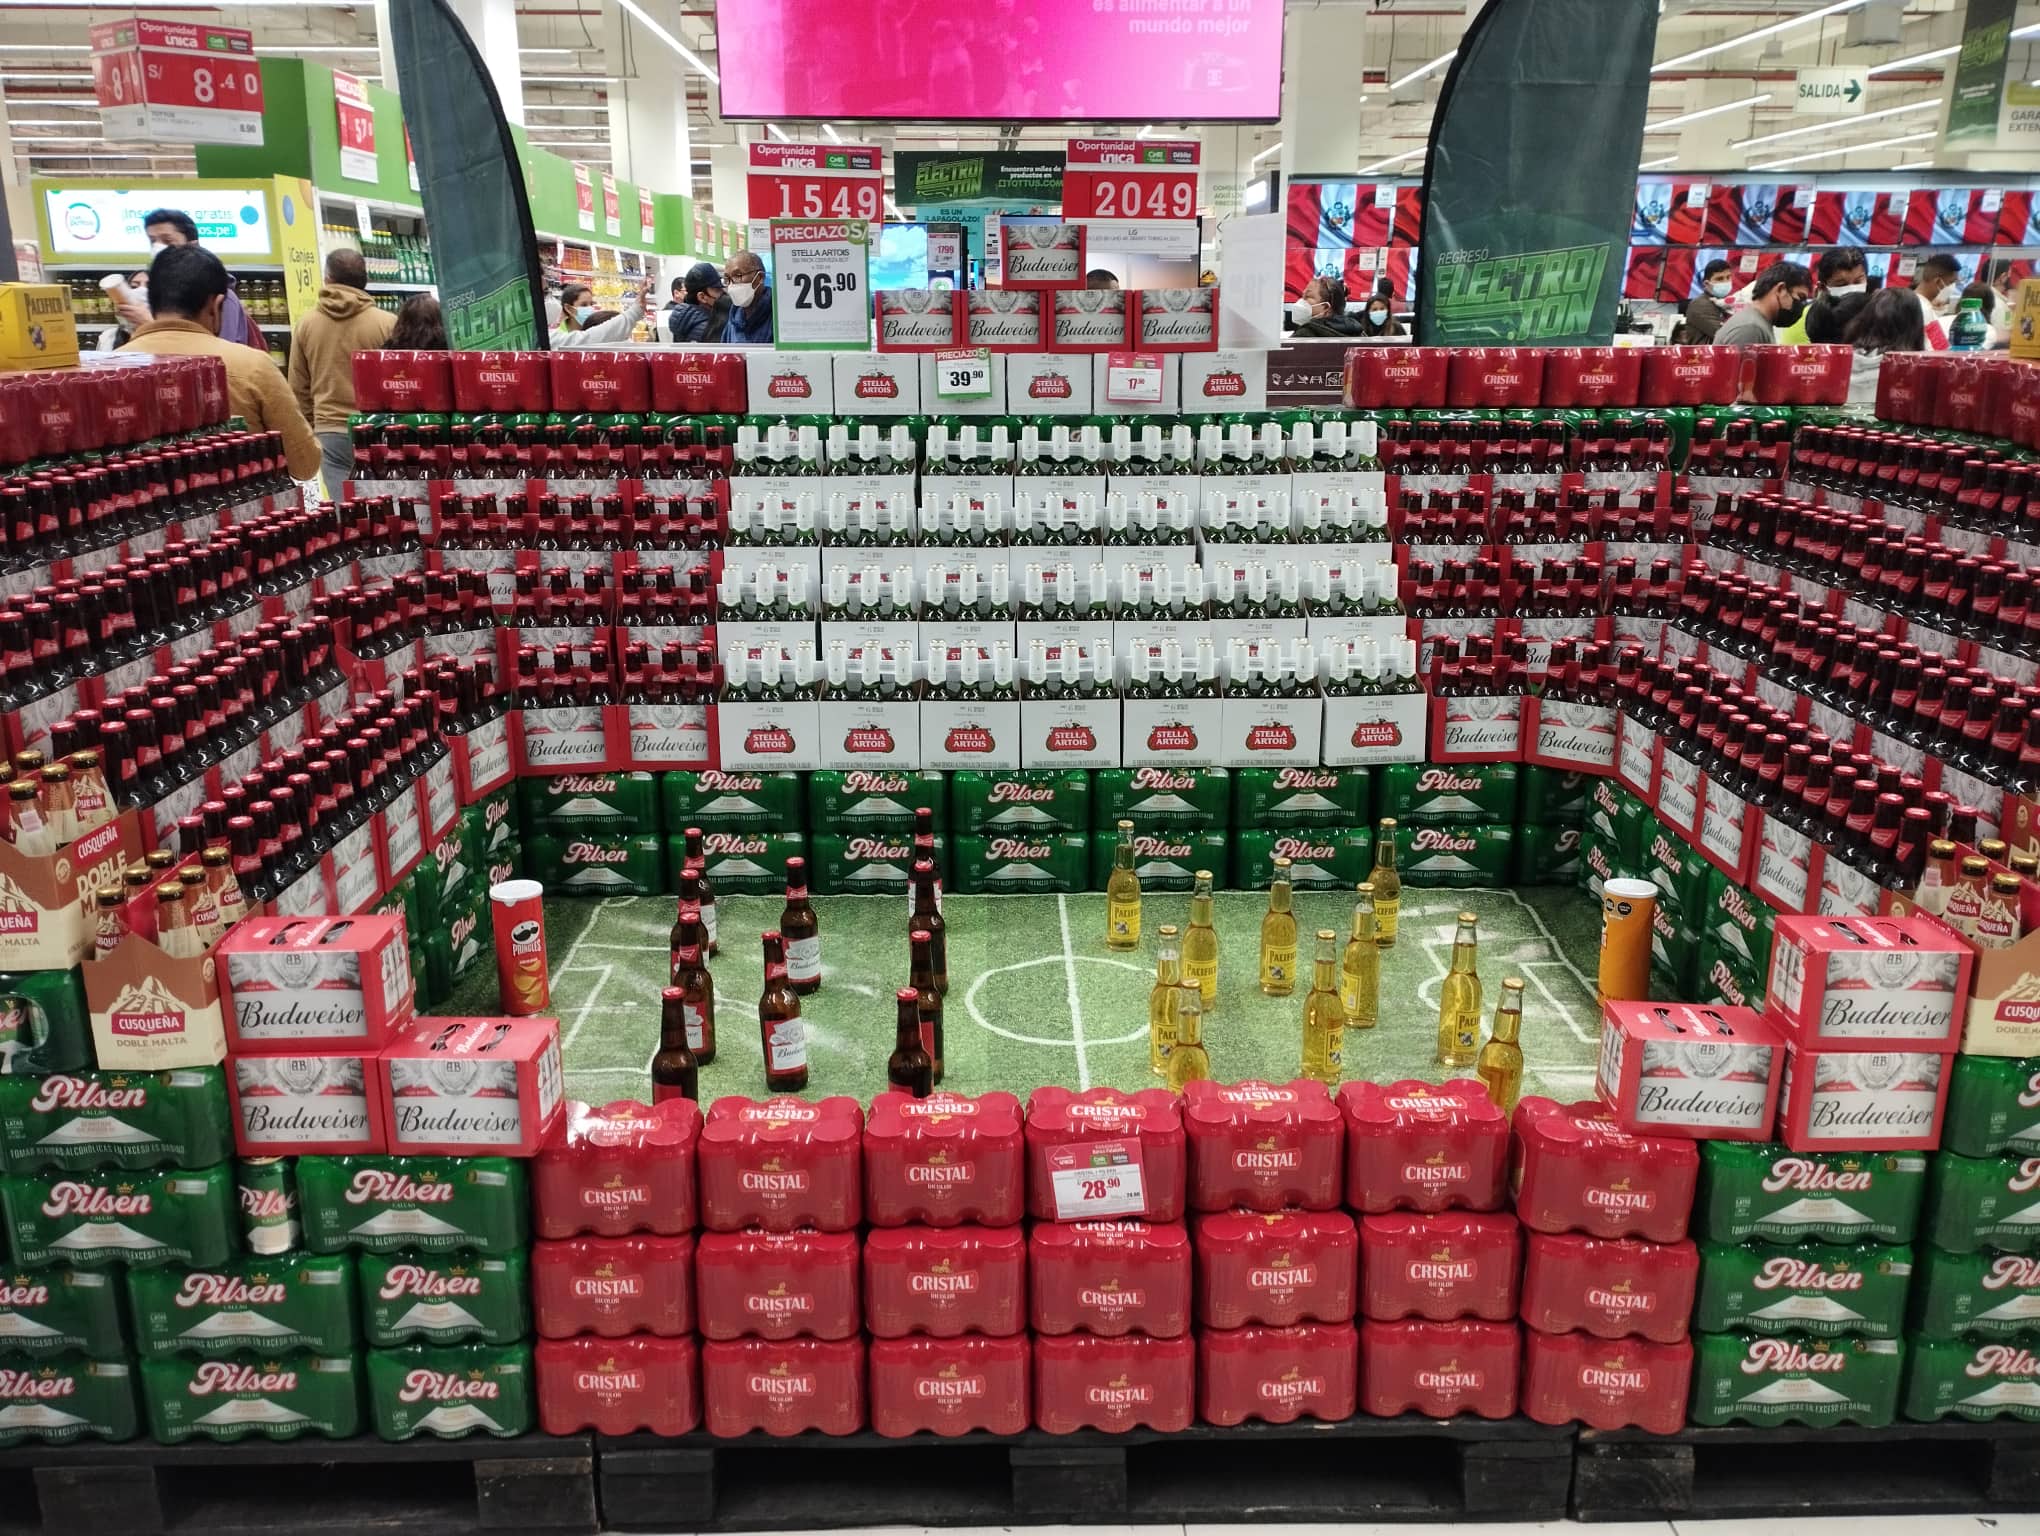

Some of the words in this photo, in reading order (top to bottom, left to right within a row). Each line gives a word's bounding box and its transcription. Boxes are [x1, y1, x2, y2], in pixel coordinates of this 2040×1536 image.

[140, 22, 197, 36] Oportunidad
[1129, 16, 1192, 33] mundo
[1197, 17, 1251, 37] mejor
[165, 33, 197, 48] única
[1800, 84, 1841, 98] SALIDA
[2011, 111, 2040, 121] GARA
[2009, 123, 2040, 132] EXTEN
[757, 144, 816, 156] Oportunidad
[1076, 141, 1136, 152] Oportunidad
[782, 154, 815, 168] única
[1100, 150, 1135, 164] única
[780, 184, 877, 219] 1549
[1095, 181, 1192, 217] 2049
[792, 249, 820, 257] STELLA
[821, 249, 850, 257] ARTOIS
[1438, 248, 1489, 265] REGRESO
[1009, 254, 1078, 274] Budweiser
[1435, 248, 1596, 306] ELECTRO
[882, 319, 952, 337] Budweiser
[969, 319, 1039, 337] Budweiser
[1056, 319, 1125, 337] Budweiser
[1143, 318, 1212, 336] Budweiser
[480, 372, 518, 383] CRISTAL
[1385, 367, 1419, 377] CRISTAL
[1791, 364, 1827, 375] CRISTAL
[383, 380, 419, 390] CRISTAL
[774, 386, 804, 394] ARTOIS
[753, 733, 786, 741] STELLA
[953, 732, 986, 740] STELLA
[1156, 730, 1188, 738] STELLA
[1360, 727, 1393, 736] STELLA
[1360, 734, 1394, 743] ARTOIS
[1446, 726, 1518, 744] Budweiser
[527, 739, 604, 758] Budweiser
[632, 733, 707, 753] Budweiser
[753, 740, 787, 749] ARTOIS
[953, 739, 987, 748] ARTOIS
[1156, 737, 1189, 745] ARTOIS
[1539, 729, 1613, 757] Budweiser
[548, 772, 616, 795] Pilsen
[1130, 767, 1196, 791] Pilsen
[1416, 769, 1483, 792] Pilsen
[78, 826, 118, 858] CUSQUEÑA
[844, 837, 910, 860] Pilsen
[562, 843, 628, 864] Pilsen
[1650, 835, 1682, 875] Pilsen
[76, 850, 128, 893] DOBLE
[1759, 854, 1806, 898] Budweiser
[1719, 885, 1756, 931] Pilsen
[513, 941, 541, 957] PRINGLES
[1710, 960, 1745, 1007] Pilsen
[236, 1000, 364, 1029] Budweiser
[1825, 998, 1951, 1027] Budweiser
[2004, 1005, 2040, 1020] CUSQU
[119, 1015, 180, 1032] CUSQUEÑA
[117, 1039, 148, 1048] DOBLE
[151, 1036, 187, 1046] MALTA
[31, 1075, 146, 1113] Pilsen
[1389, 1096, 1462, 1109] CRISTAL
[1639, 1086, 1764, 1116] Budweiser
[243, 1105, 367, 1133] Budweiser
[396, 1106, 520, 1134] Budweiser
[745, 1108, 815, 1121] CRISTAL
[1072, 1105, 1142, 1117] CRISTAL
[1812, 1099, 1934, 1127] Budweiser
[1574, 1118, 1620, 1132] CRIS
[1237, 1152, 1297, 1169] CRISTAL
[909, 1166, 971, 1183] CRISTAL
[1762, 1158, 1872, 1193] Pilsen
[345, 1169, 454, 1204] Pilsen
[1082, 1177, 1121, 1200] 28.90
[42, 1181, 152, 1217] Pilsen
[584, 1188, 647, 1205] CRISTAL
[1587, 1189, 1651, 1209] CRISTAL
[1410, 1263, 1472, 1280] CRISTAL
[1753, 1257, 1863, 1290] Pilsen
[176, 1273, 286, 1307] Pilsen
[380, 1264, 481, 1300] Pilsen
[575, 1279, 639, 1296] CRISTAL
[0, 1278, 49, 1305] lsen
[1082, 1291, 1141, 1306] CRISTAL
[1741, 1339, 1845, 1374] Pilsen
[189, 1362, 297, 1396] Pilsen
[399, 1368, 499, 1402] Pilsen
[751, 1377, 811, 1394] CRISTAL
[1582, 1369, 1645, 1389] CRISTAL
[1262, 1380, 1321, 1398] CRISTAL
